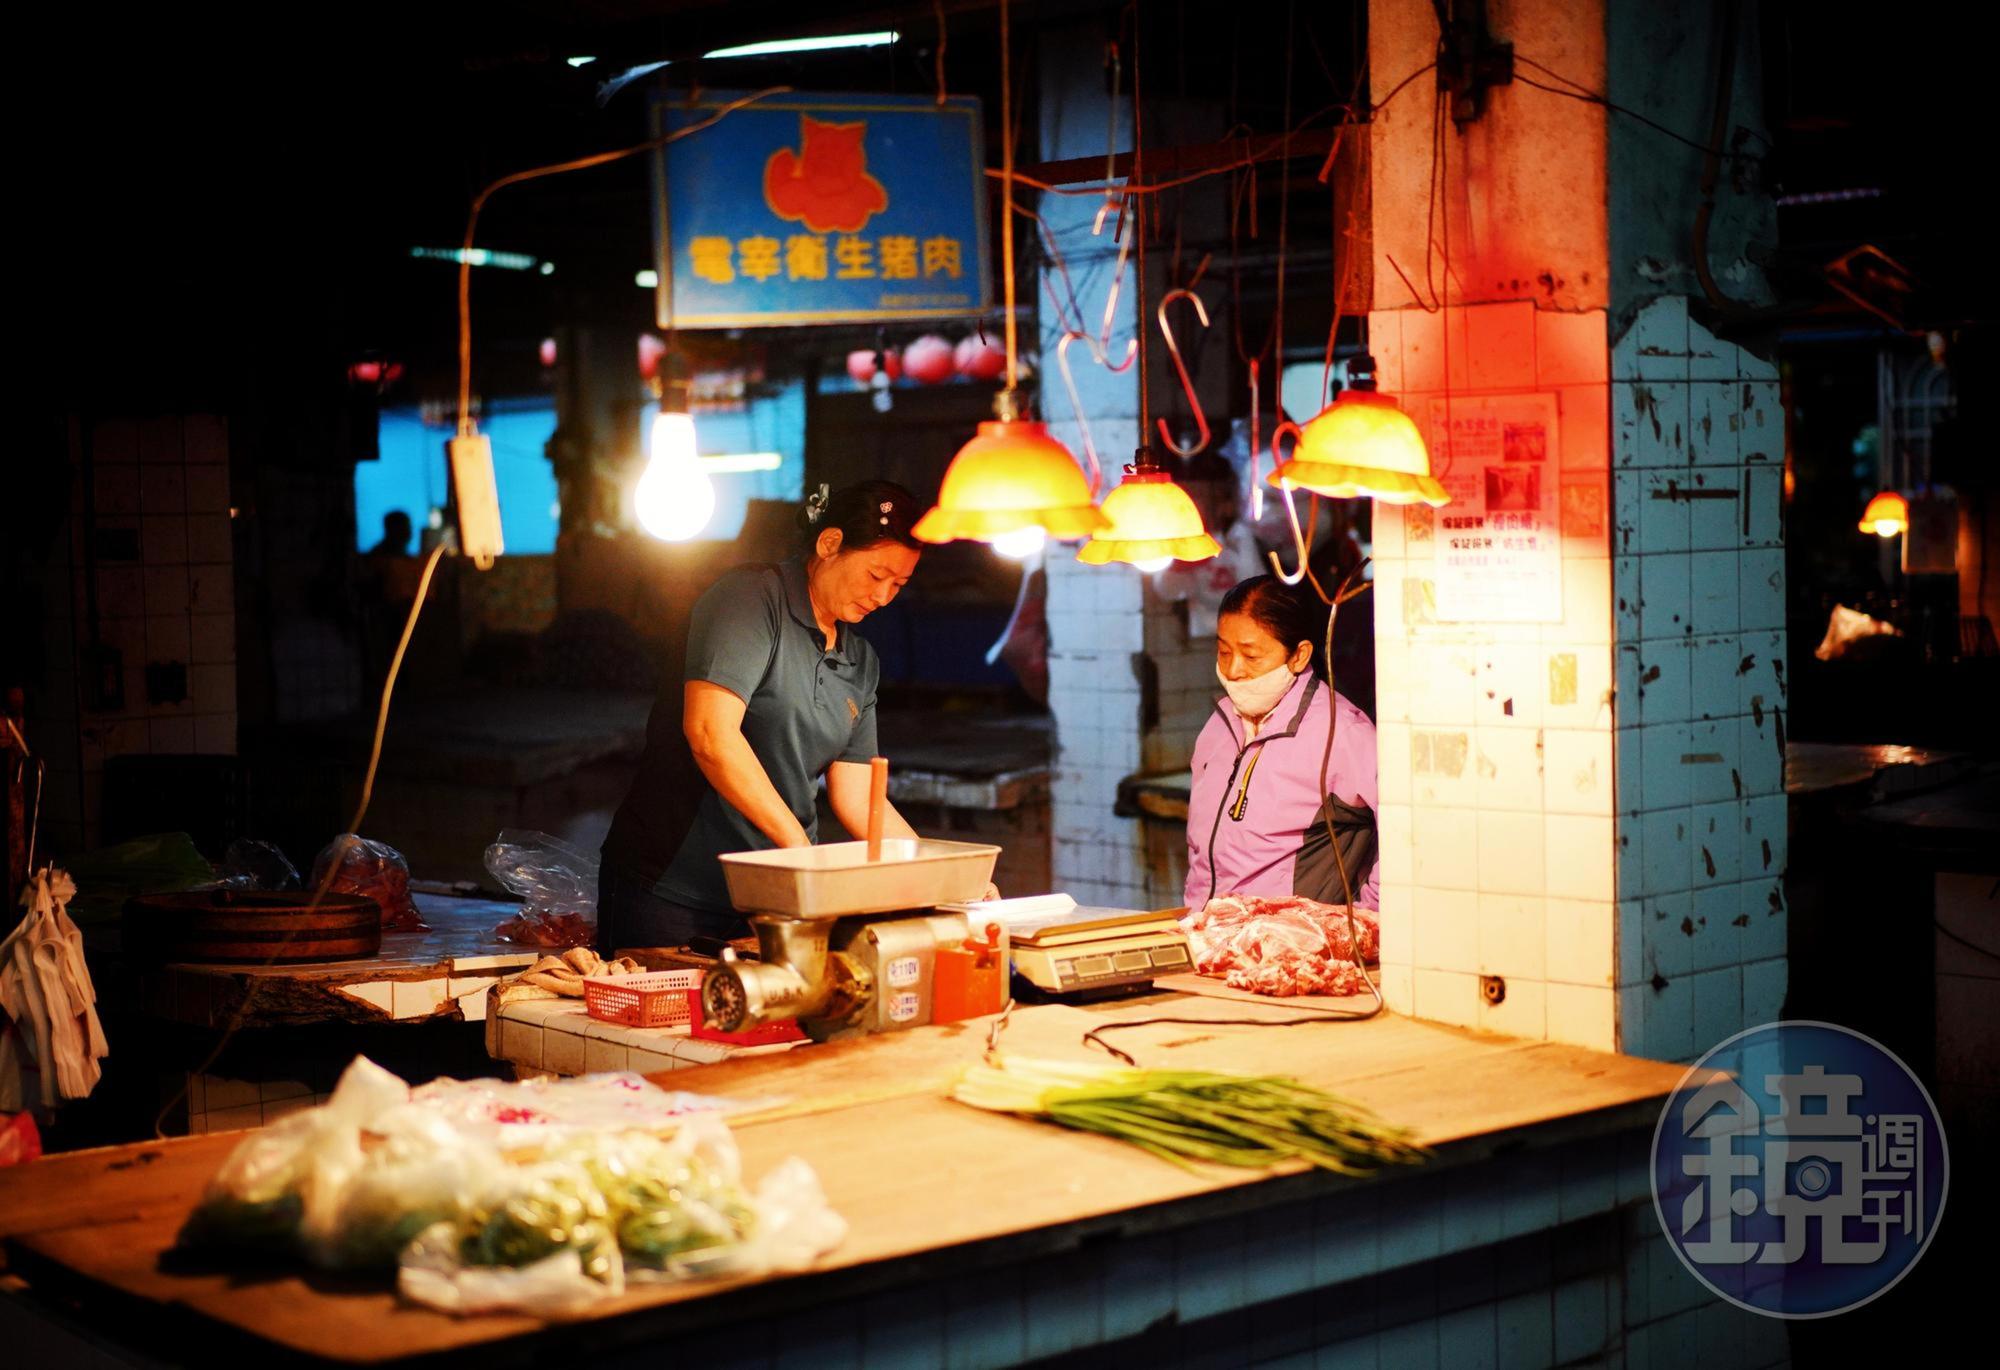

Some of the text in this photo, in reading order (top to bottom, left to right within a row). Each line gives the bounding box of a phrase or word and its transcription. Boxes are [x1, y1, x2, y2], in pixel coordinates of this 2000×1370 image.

[690, 235, 963, 284] 電宰衛生豬肉
